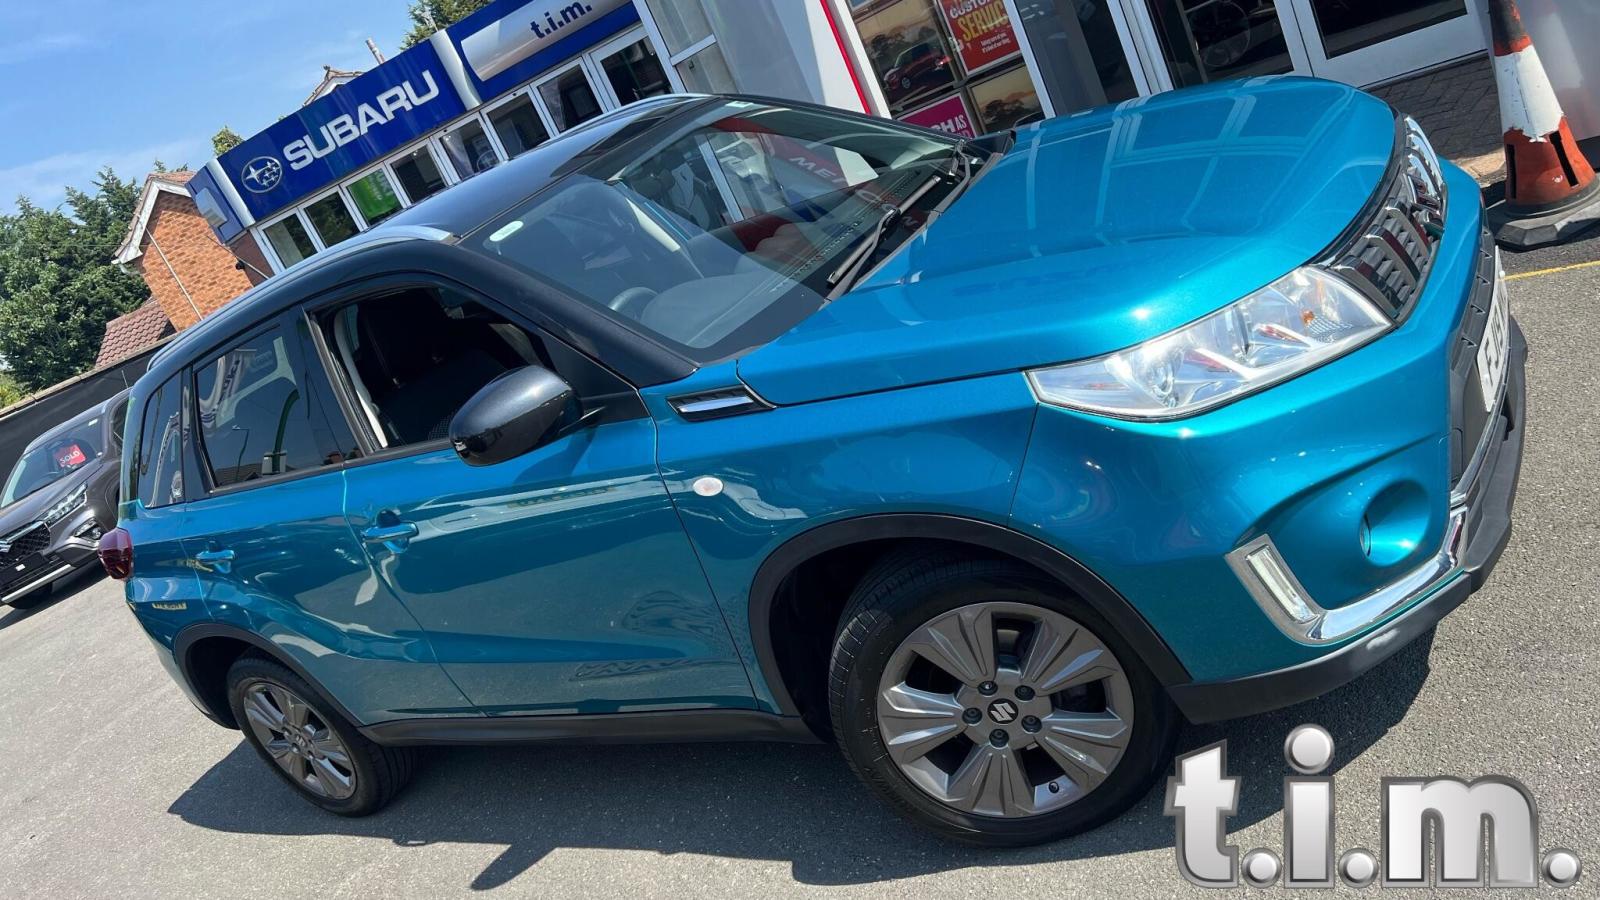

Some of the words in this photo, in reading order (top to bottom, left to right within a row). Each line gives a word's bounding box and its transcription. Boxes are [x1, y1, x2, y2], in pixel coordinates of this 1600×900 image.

[530, 1, 593, 39] t.i.m.
[949, 0, 991, 18] CUSTO
[957, 1, 1009, 41] SERVIC
[283, 69, 440, 171] SUBARU
[59, 450, 81, 466] SOLD
